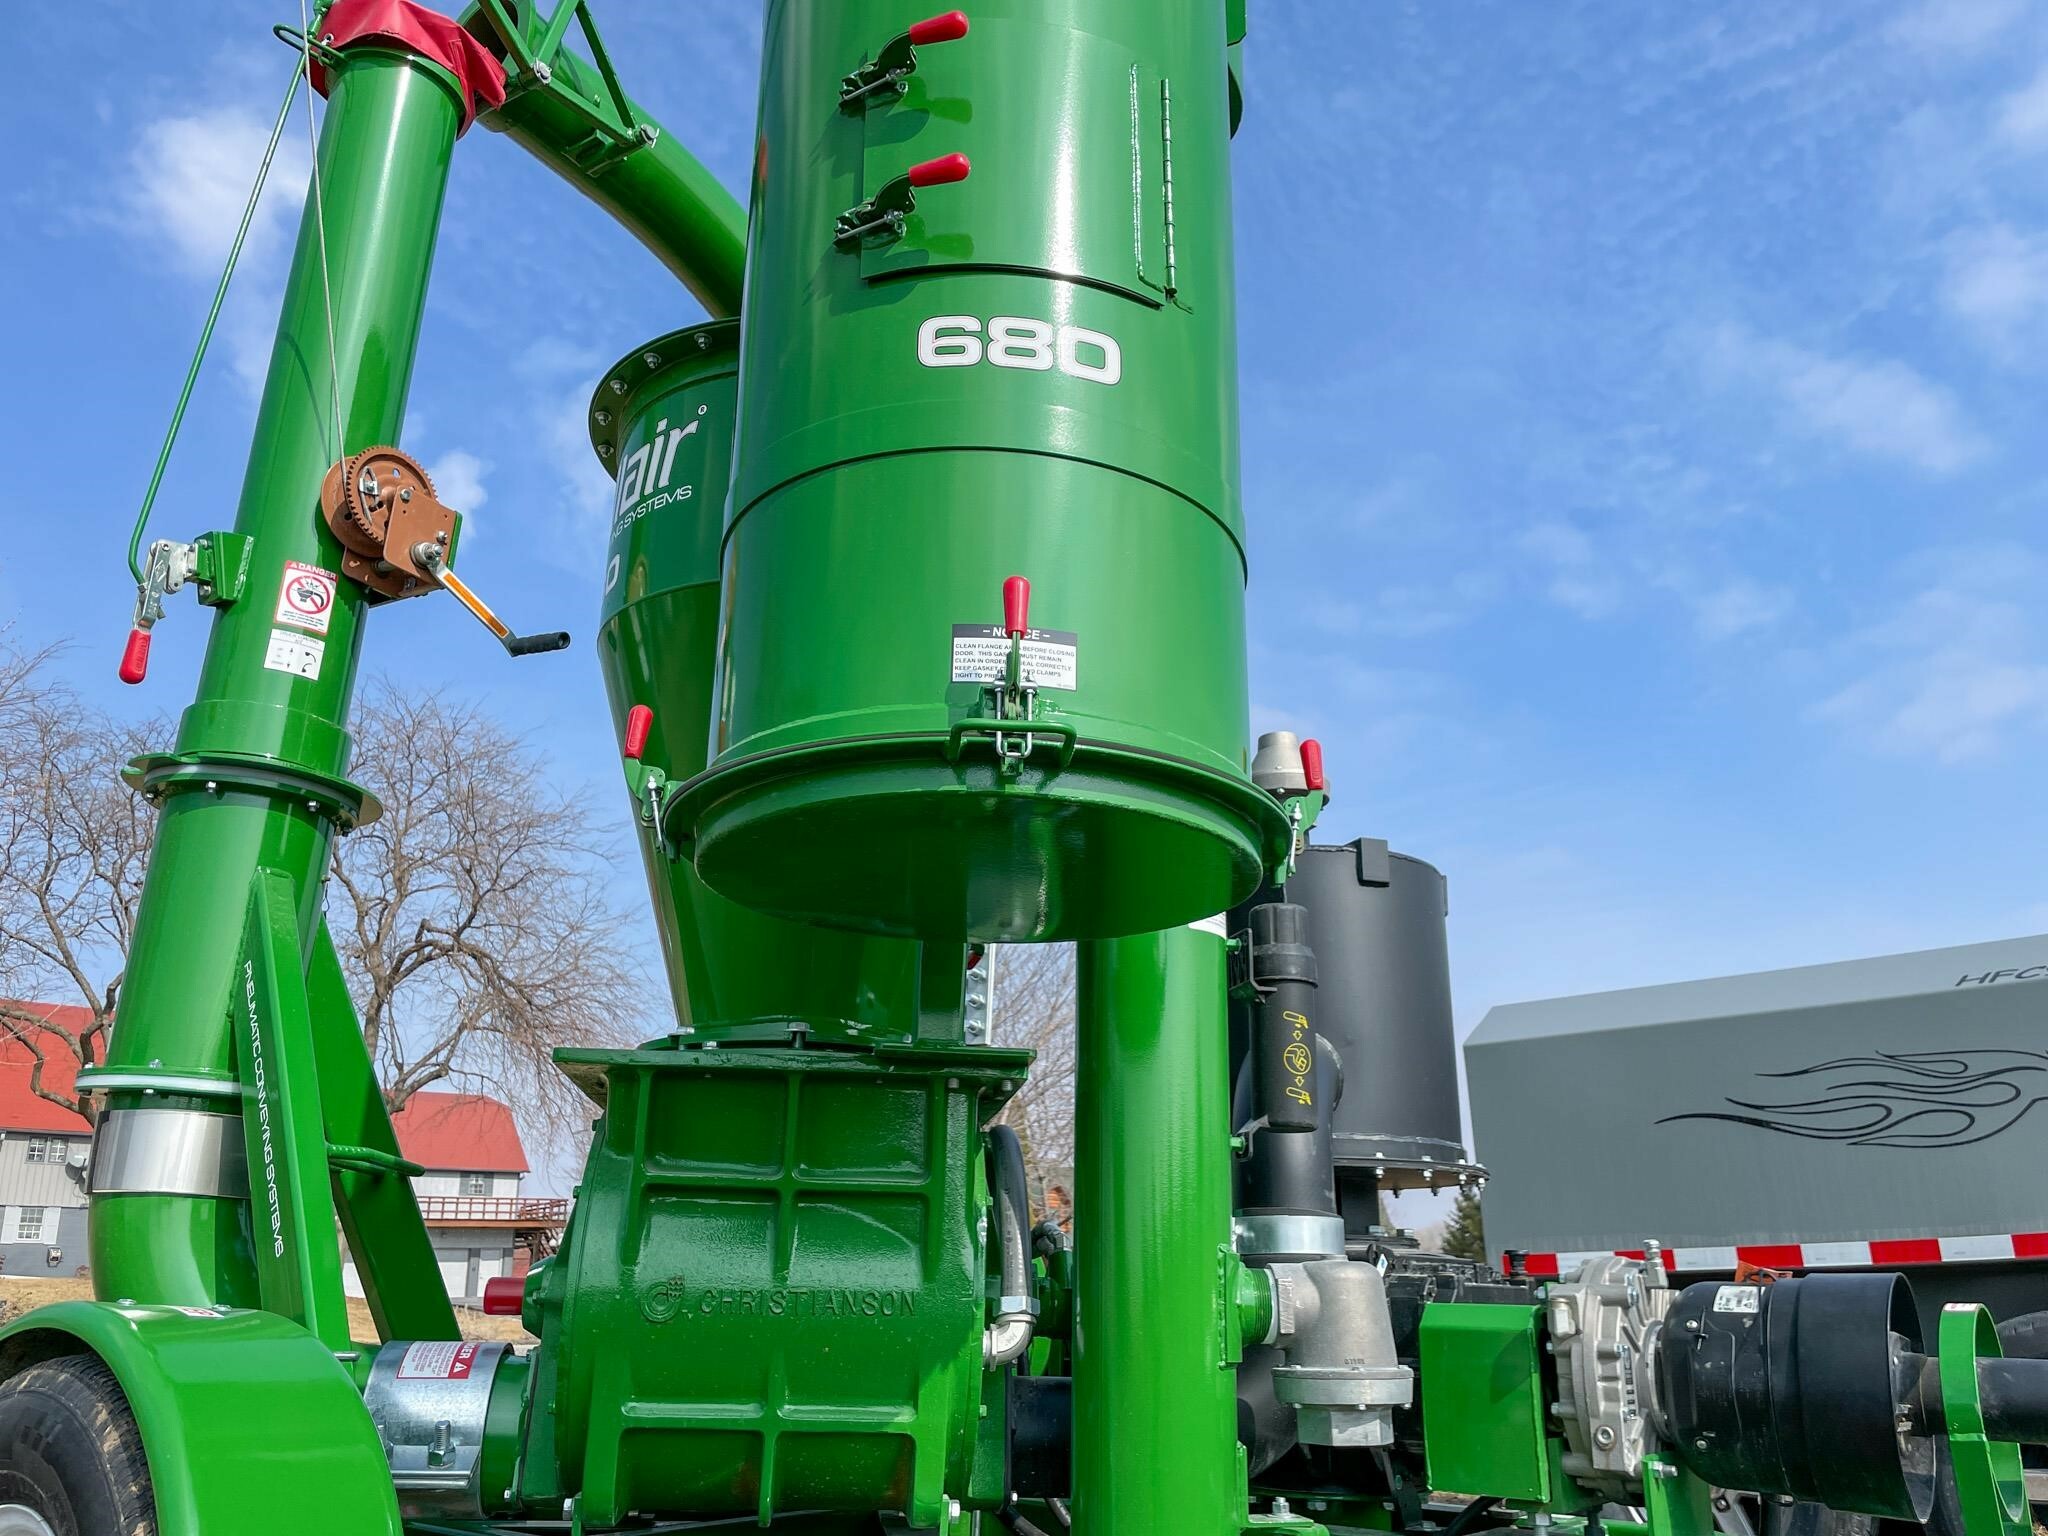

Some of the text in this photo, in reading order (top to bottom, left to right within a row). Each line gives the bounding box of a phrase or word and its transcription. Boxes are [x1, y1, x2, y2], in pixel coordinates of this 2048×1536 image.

[917, 315, 1122, 386] 680
[623, 485, 692, 529] SYSTEMS
[298, 562, 337, 580] DANGER
[992, 626, 1040, 640] NCE
[1022, 645, 1048, 654] BEFORE
[1048, 648, 1075, 658] CLOSING
[1038, 655, 1062, 663] REMAIN
[1036, 669, 1062, 678] CLAMPS
[1954, 965, 2048, 987] HFC
[244, 960, 284, 1258] PNEUMATIC CONVEYING SYSTEMS
[701, 1286, 915, 1316] CHRISTIANSON
